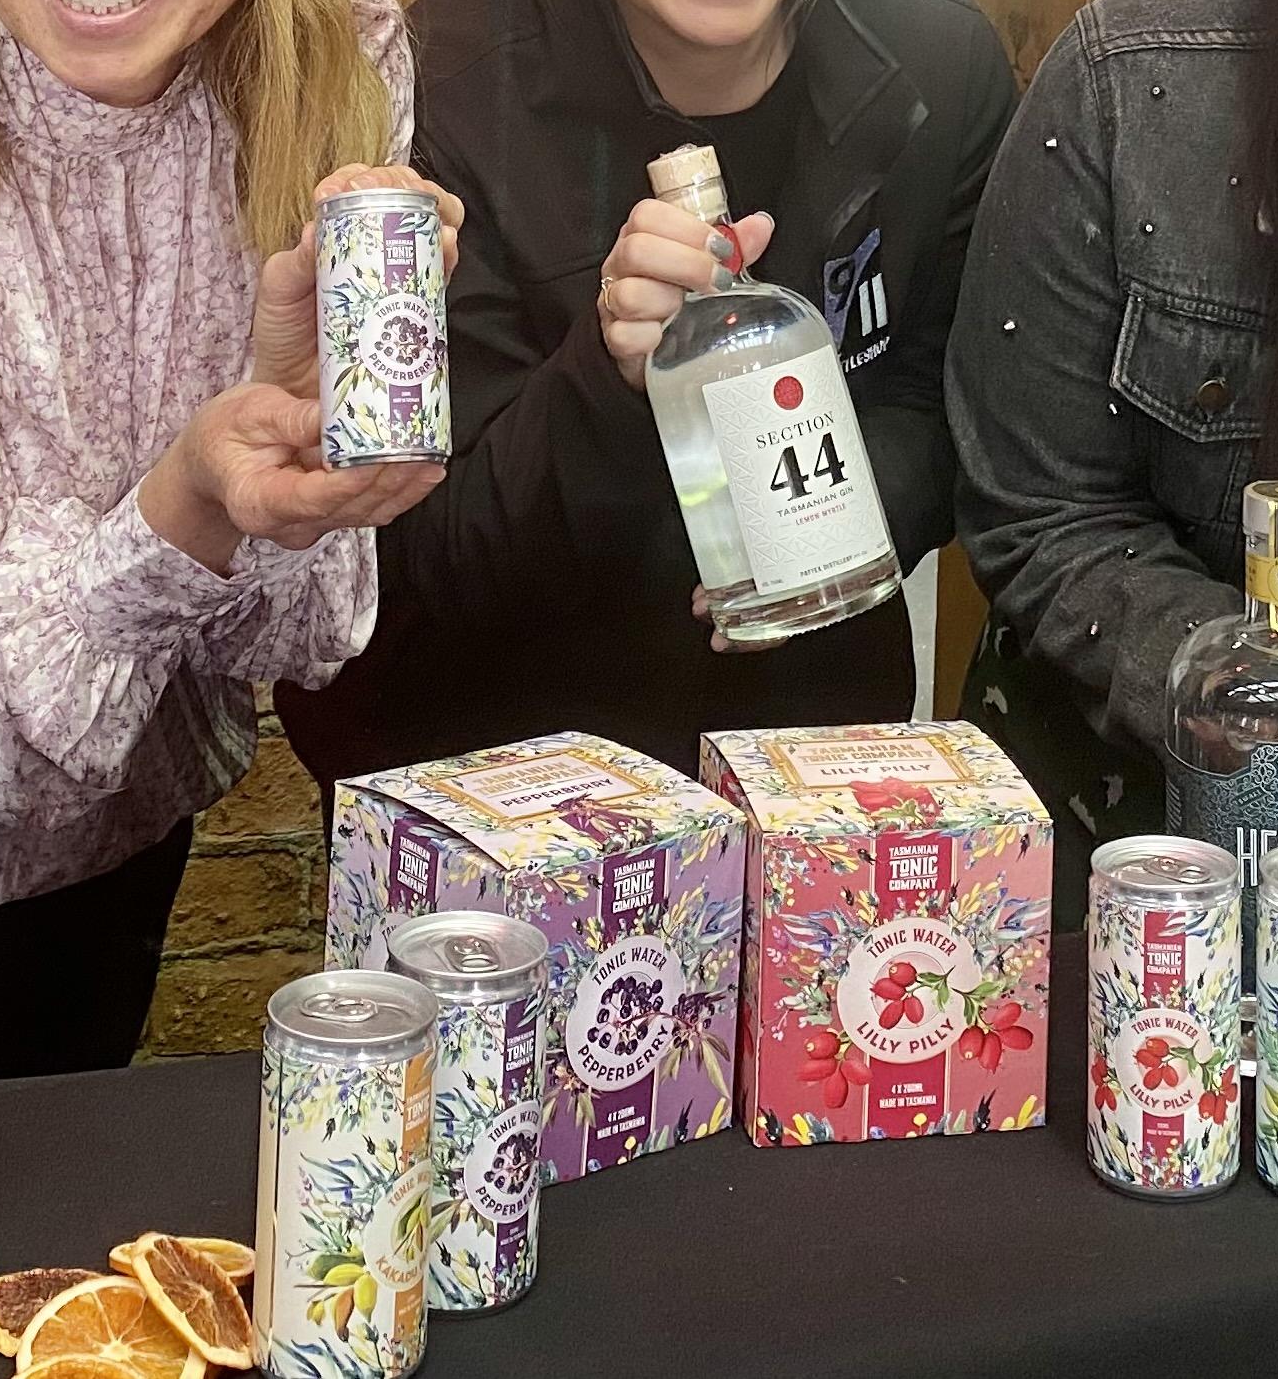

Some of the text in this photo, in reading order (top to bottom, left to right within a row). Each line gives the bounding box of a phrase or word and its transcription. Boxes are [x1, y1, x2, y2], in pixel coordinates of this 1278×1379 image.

[386, 246, 414, 258] TONIC
[375, 301, 428, 320] TONIC WATER
[369, 352, 433, 381] PEPPERBERRY
[755, 410, 835, 449] SECTION
[770, 432, 848, 501] 44
[777, 486, 854, 517] TASMANIAN GIN
[795, 512, 820, 526] LEMON
[852, 750, 933, 760] COMPANY
[820, 764, 932, 775] LILLY PILLY
[501, 778, 614, 807] PEPPERBERRY
[400, 836, 430, 861] TASMANIAN
[889, 845, 939, 857] TASMANIAN
[399, 851, 429, 881] TONIC
[613, 859, 655, 877] TASMANIAN
[889, 856, 938, 879] TONIC
[397, 870, 428, 896] COMPANY
[613, 871, 653, 901] TONIC
[889, 877, 937, 891] COMPANY
[612, 893, 653, 913] COMPANY
[867, 928, 958, 958] TONIC WATER
[592, 947, 668, 985] TONIC WATER
[1146, 965, 1181, 975] COMPANY
[1147, 952, 1182, 965] TONIC
[856, 1018, 954, 1053] LILLY PILLY
[1131, 1017, 1199, 1040] TONIC WATER
[506, 1038, 534, 1061] TONIC
[578, 1024, 668, 1081] PEPPERBERRY
[891, 1085, 897, 1094] 4
[1130, 1083, 1194, 1110] LILLY PILLY
[489, 1114, 518, 1144] TONIC
[375, 1255, 419, 1284] KAKADU
